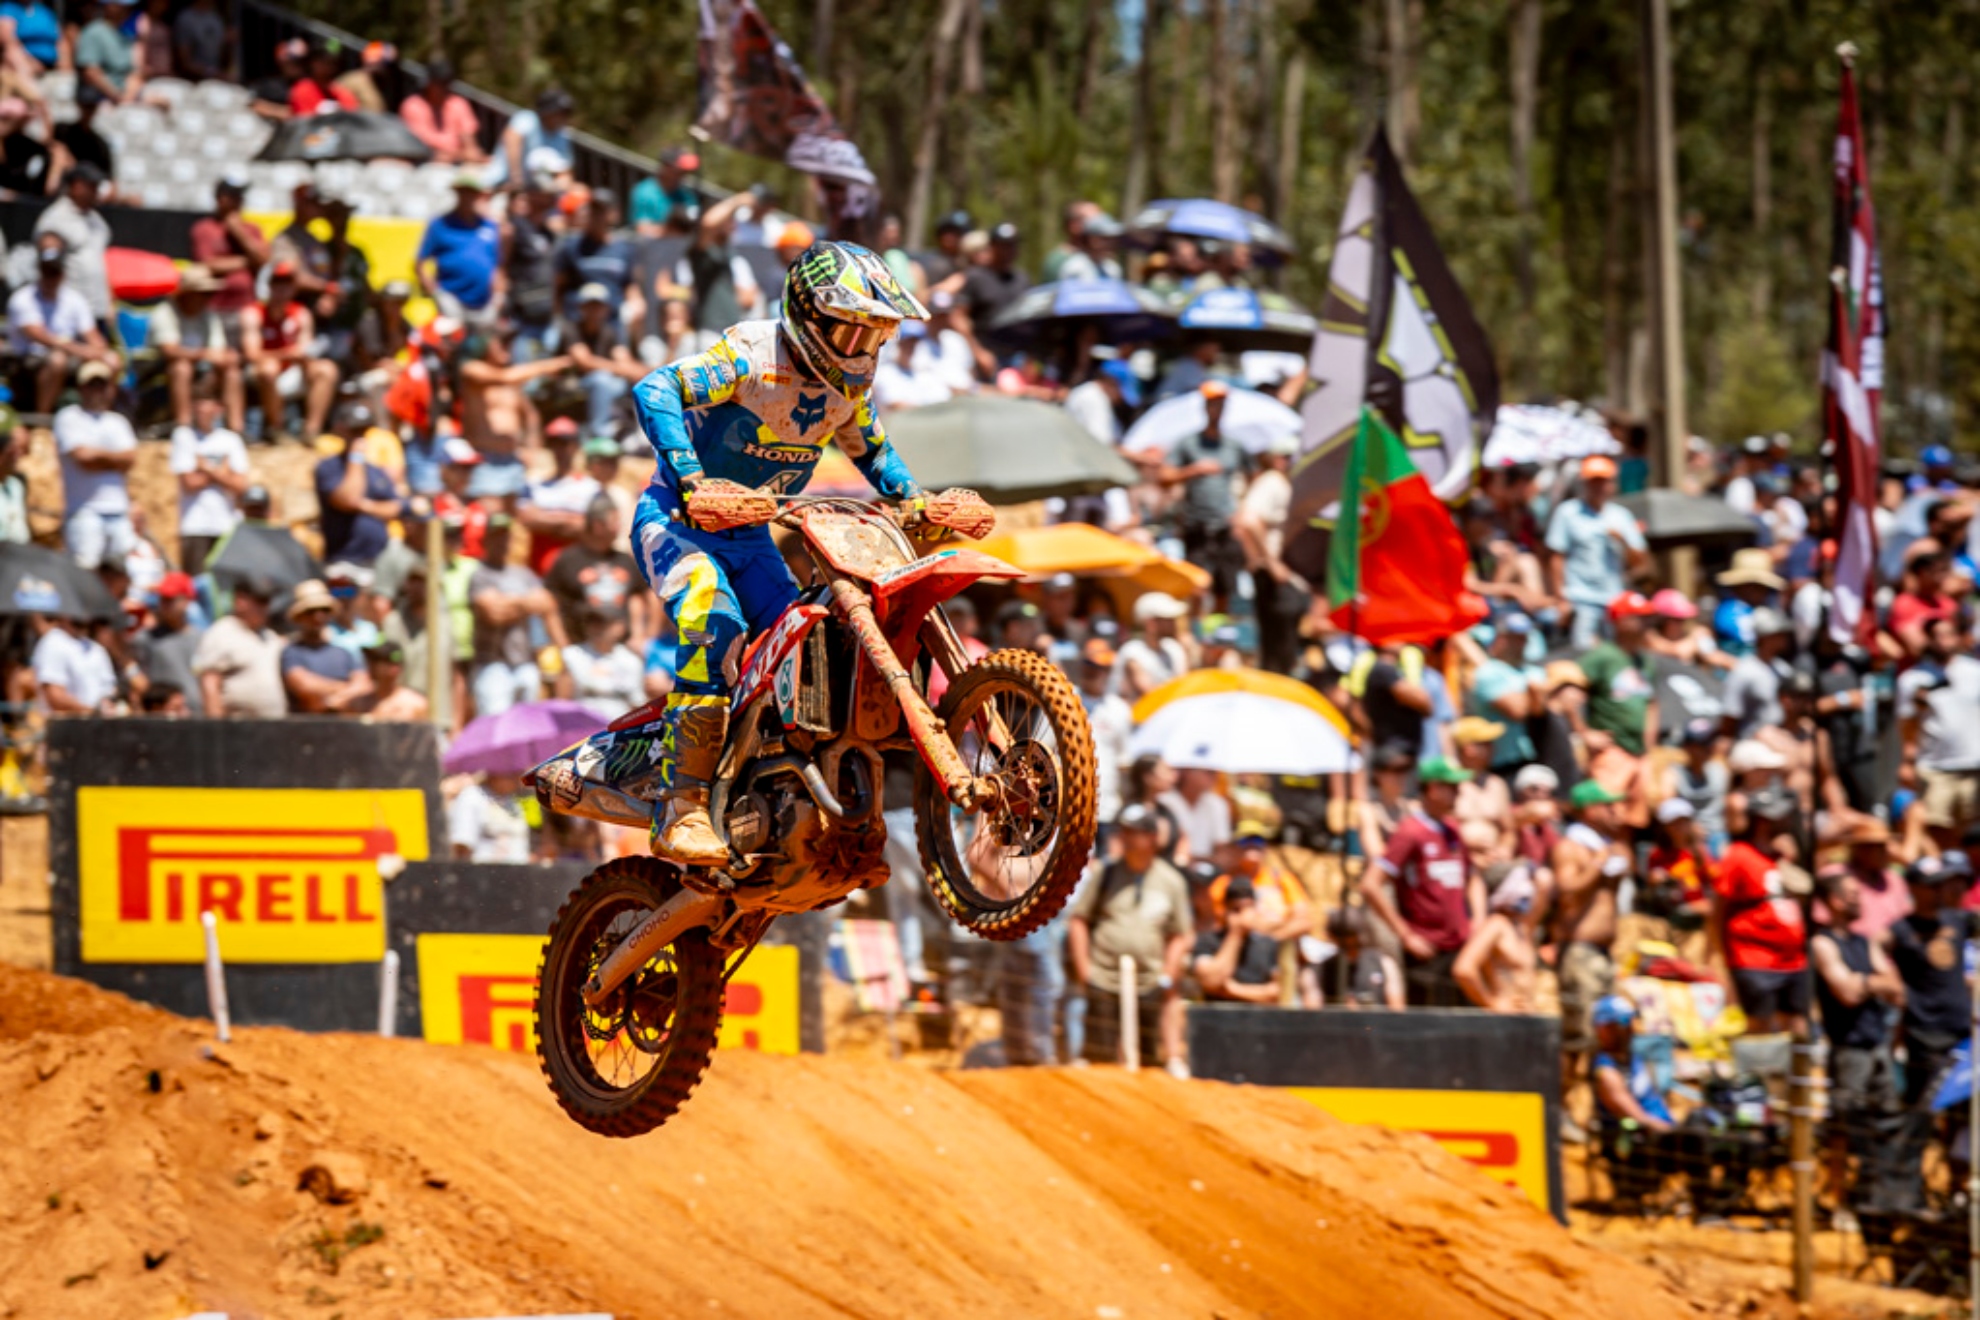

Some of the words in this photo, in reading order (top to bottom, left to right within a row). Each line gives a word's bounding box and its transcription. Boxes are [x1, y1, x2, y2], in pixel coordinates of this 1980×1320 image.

[744, 442, 822, 463] HONDA
[118, 828, 397, 922] PIRELL
[629, 909, 669, 949] CHOHO
